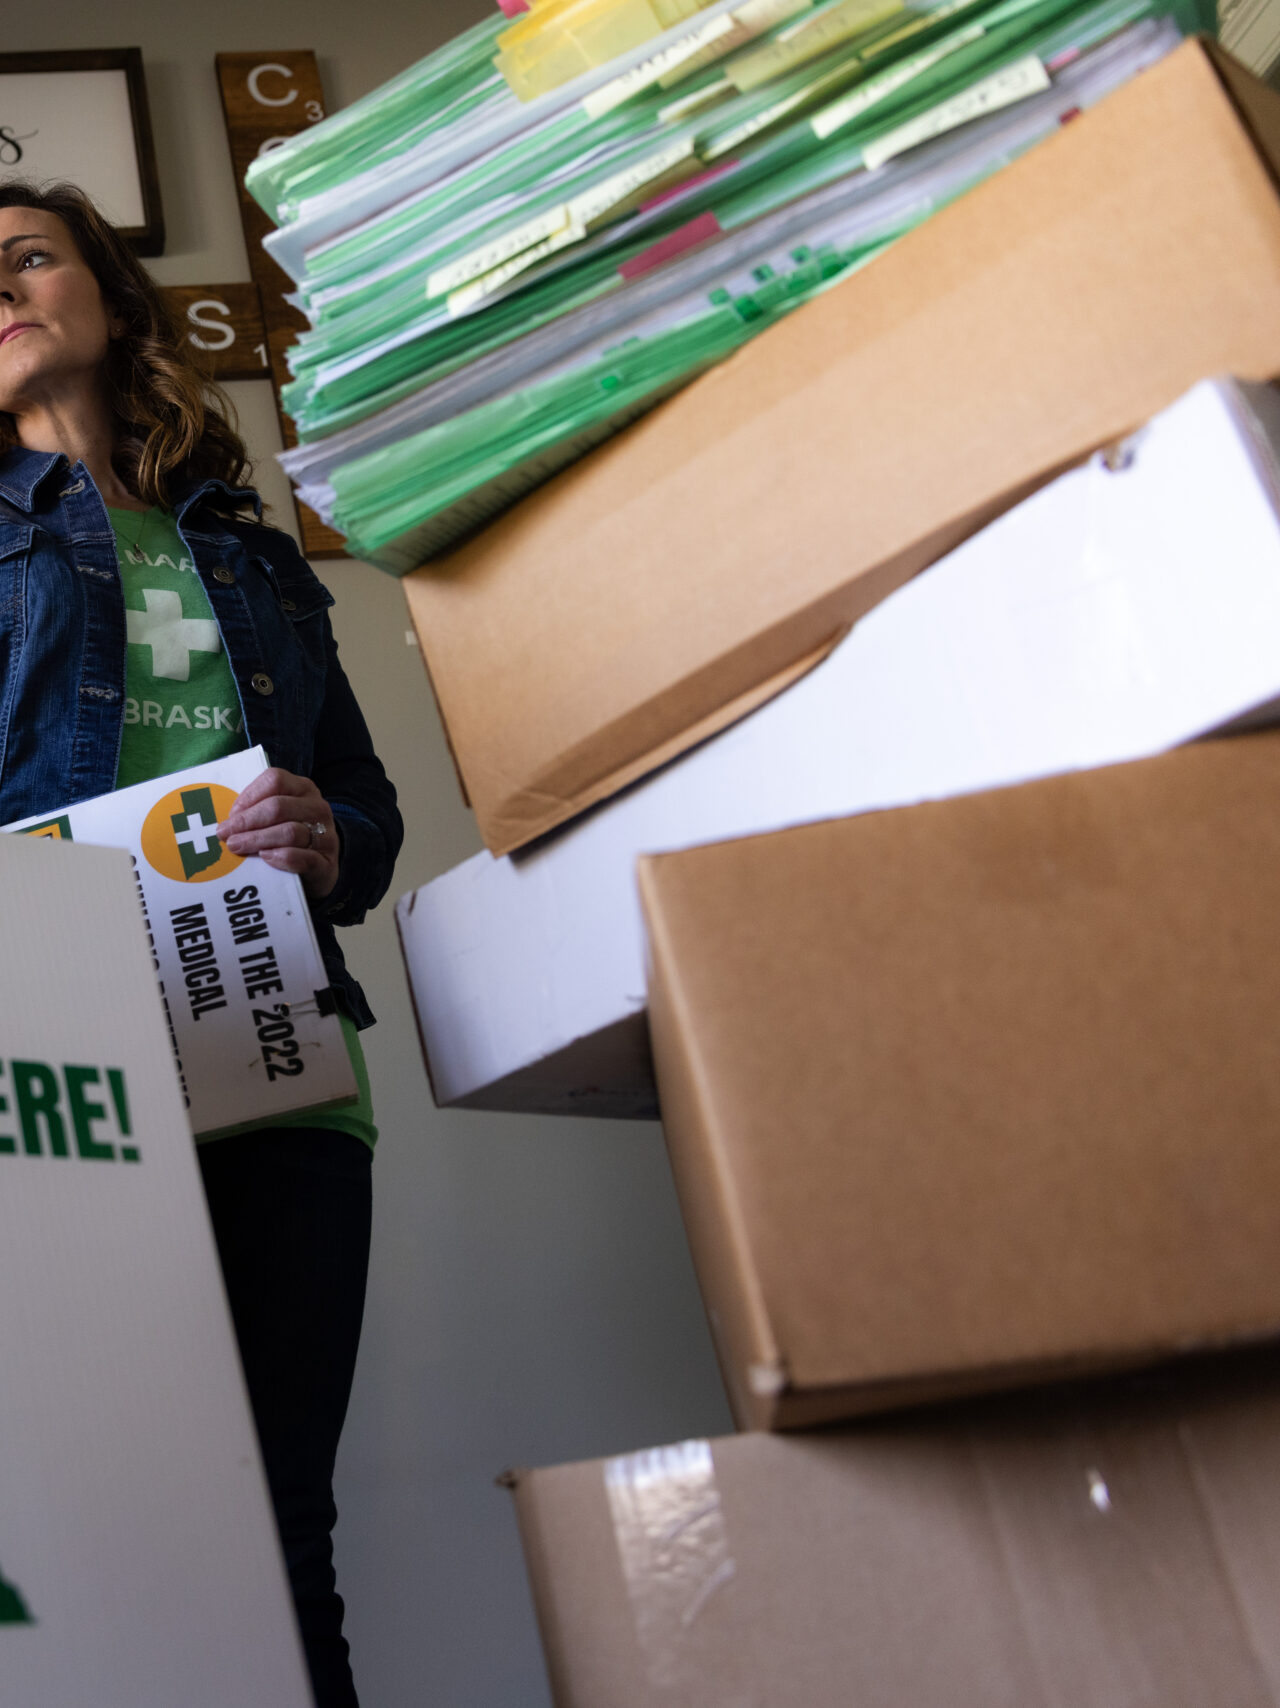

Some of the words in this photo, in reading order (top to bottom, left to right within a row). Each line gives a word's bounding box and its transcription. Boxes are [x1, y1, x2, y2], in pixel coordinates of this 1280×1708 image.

[247, 63, 299, 107] C
[305, 100, 324, 122] 3
[187, 300, 236, 351] S
[254, 344, 268, 368] 1
[223, 885, 270, 945] SIGN
[170, 903, 228, 1021] MEDICAL
[239, 946, 284, 1000] THE
[252, 1003, 305, 1082] 2022
